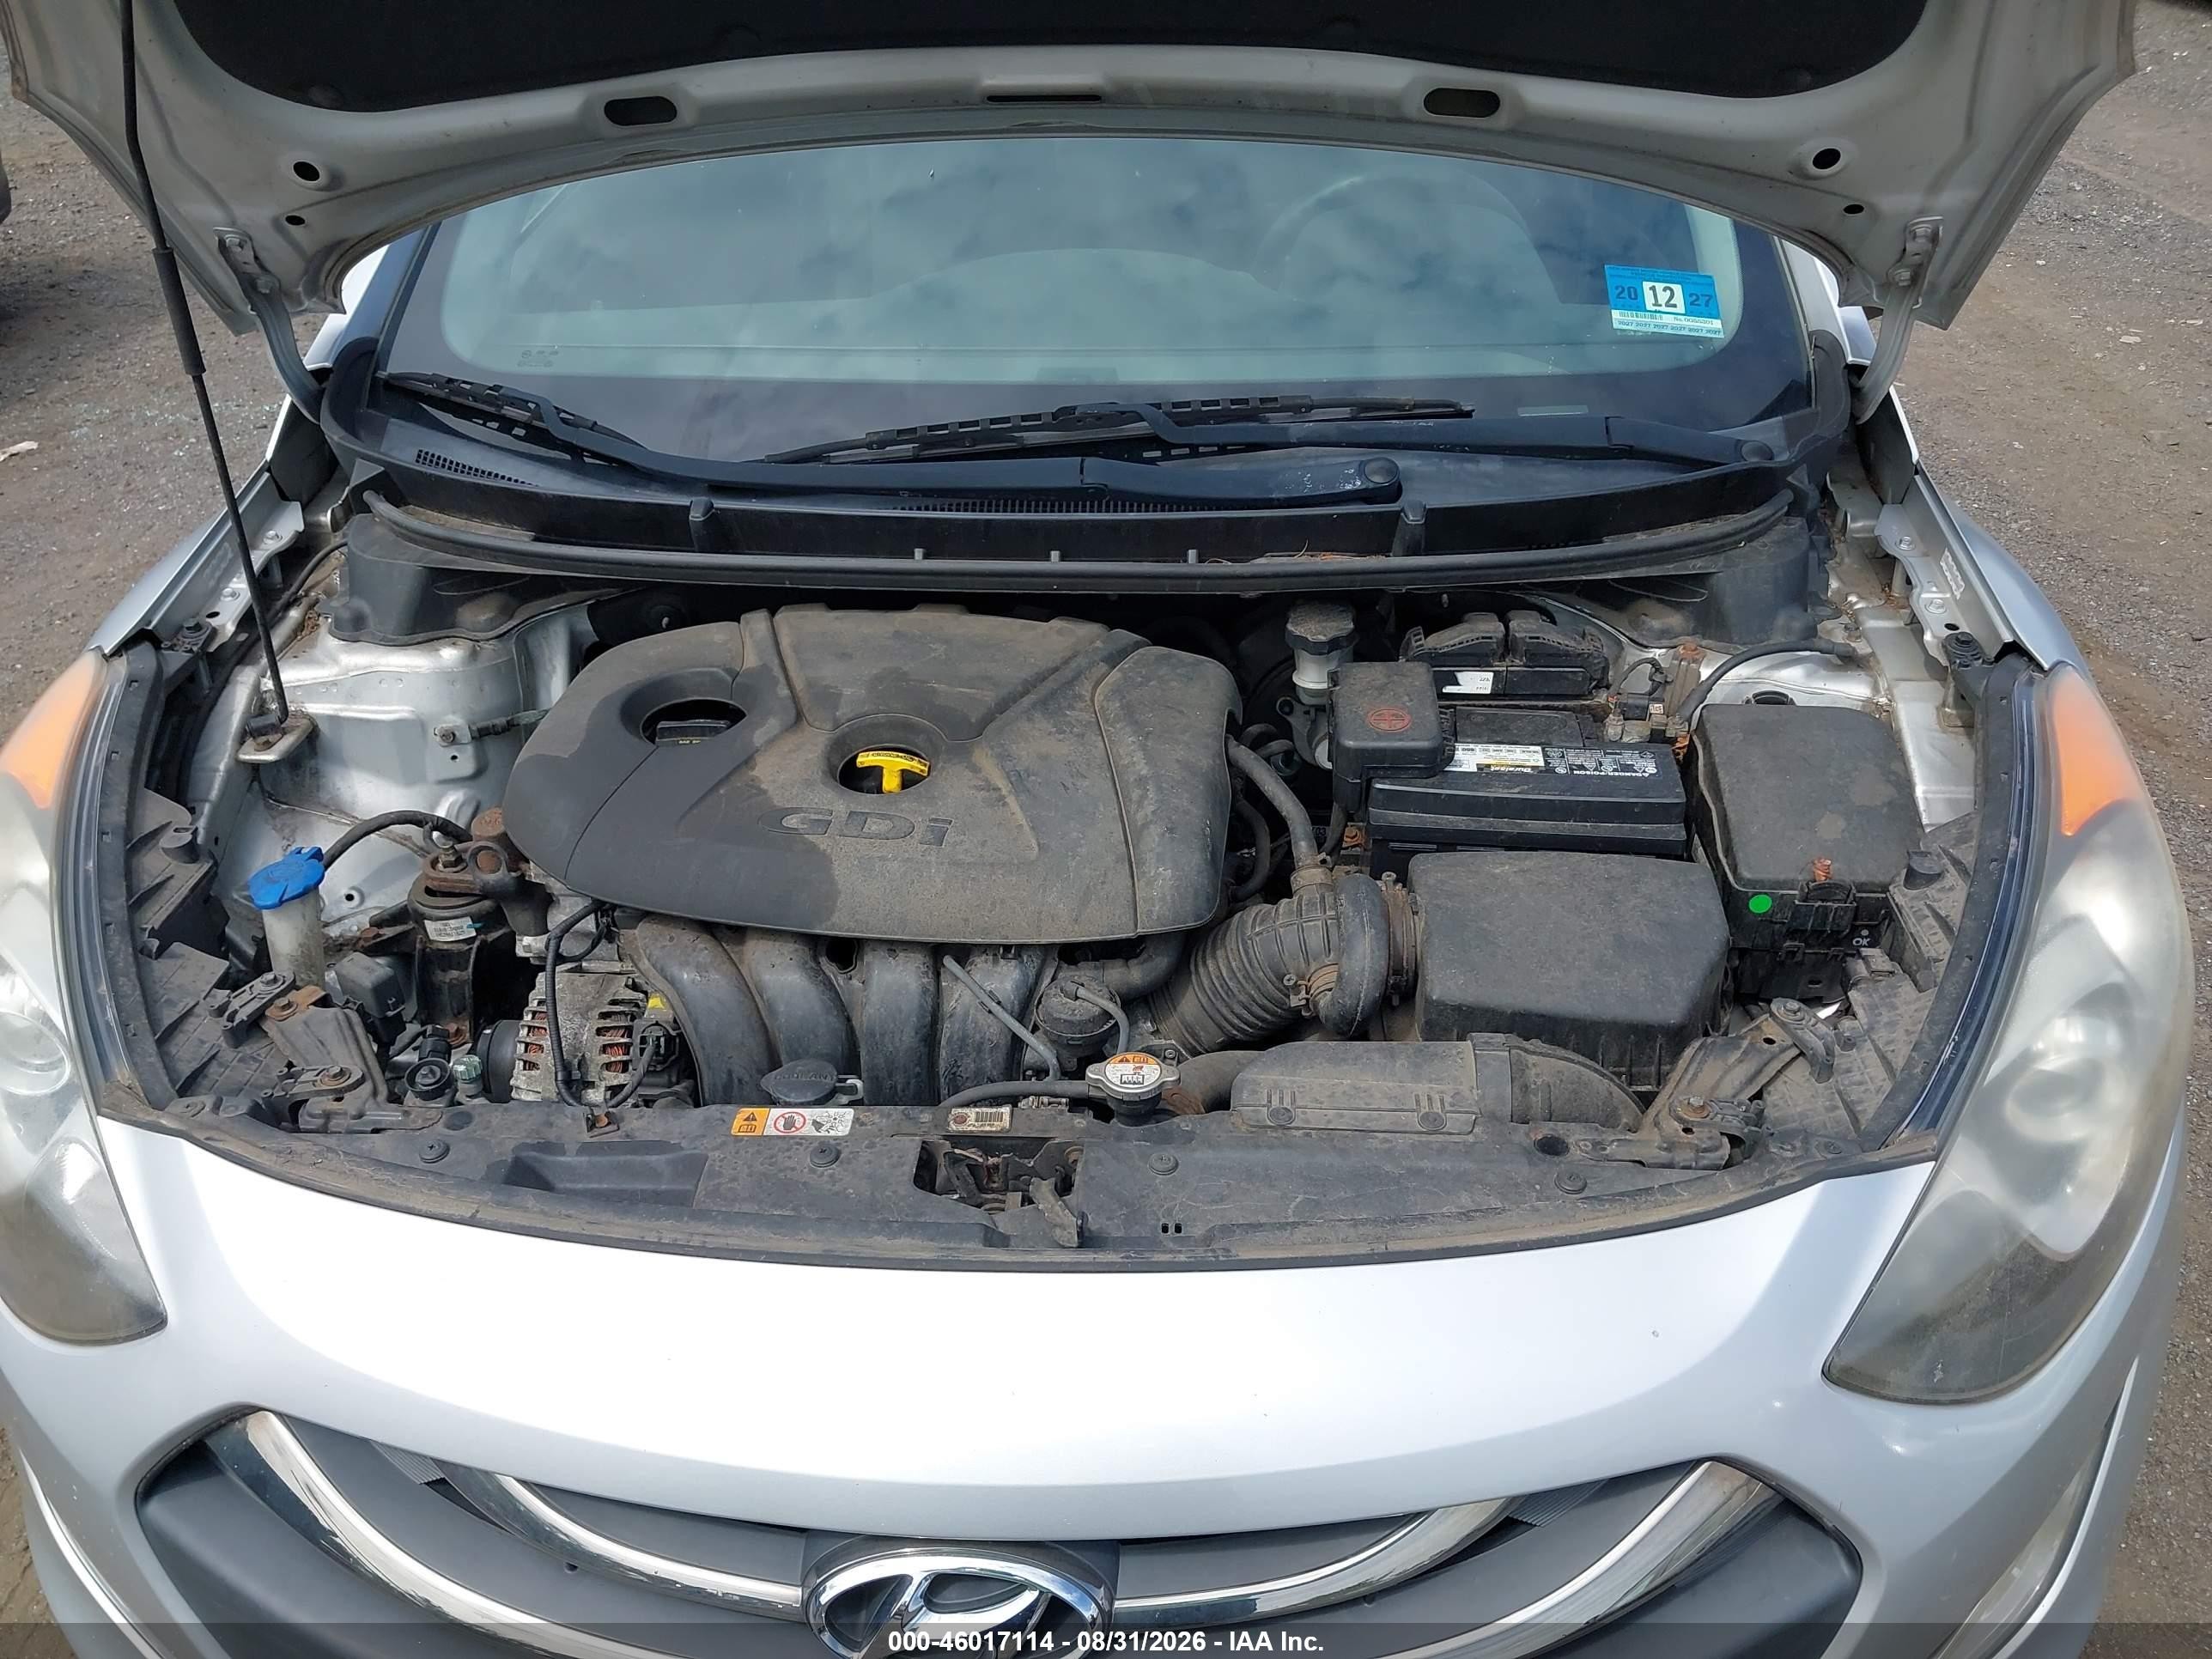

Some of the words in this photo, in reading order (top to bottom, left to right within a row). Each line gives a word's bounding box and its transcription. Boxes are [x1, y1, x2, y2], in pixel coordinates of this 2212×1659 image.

[1614, 284, 1638, 301] 20
[1648, 284, 1678, 308] 12
[1688, 293, 1713, 307] 27
[758, 806, 954, 847] GDi
[1852, 938, 1871, 946] OK
